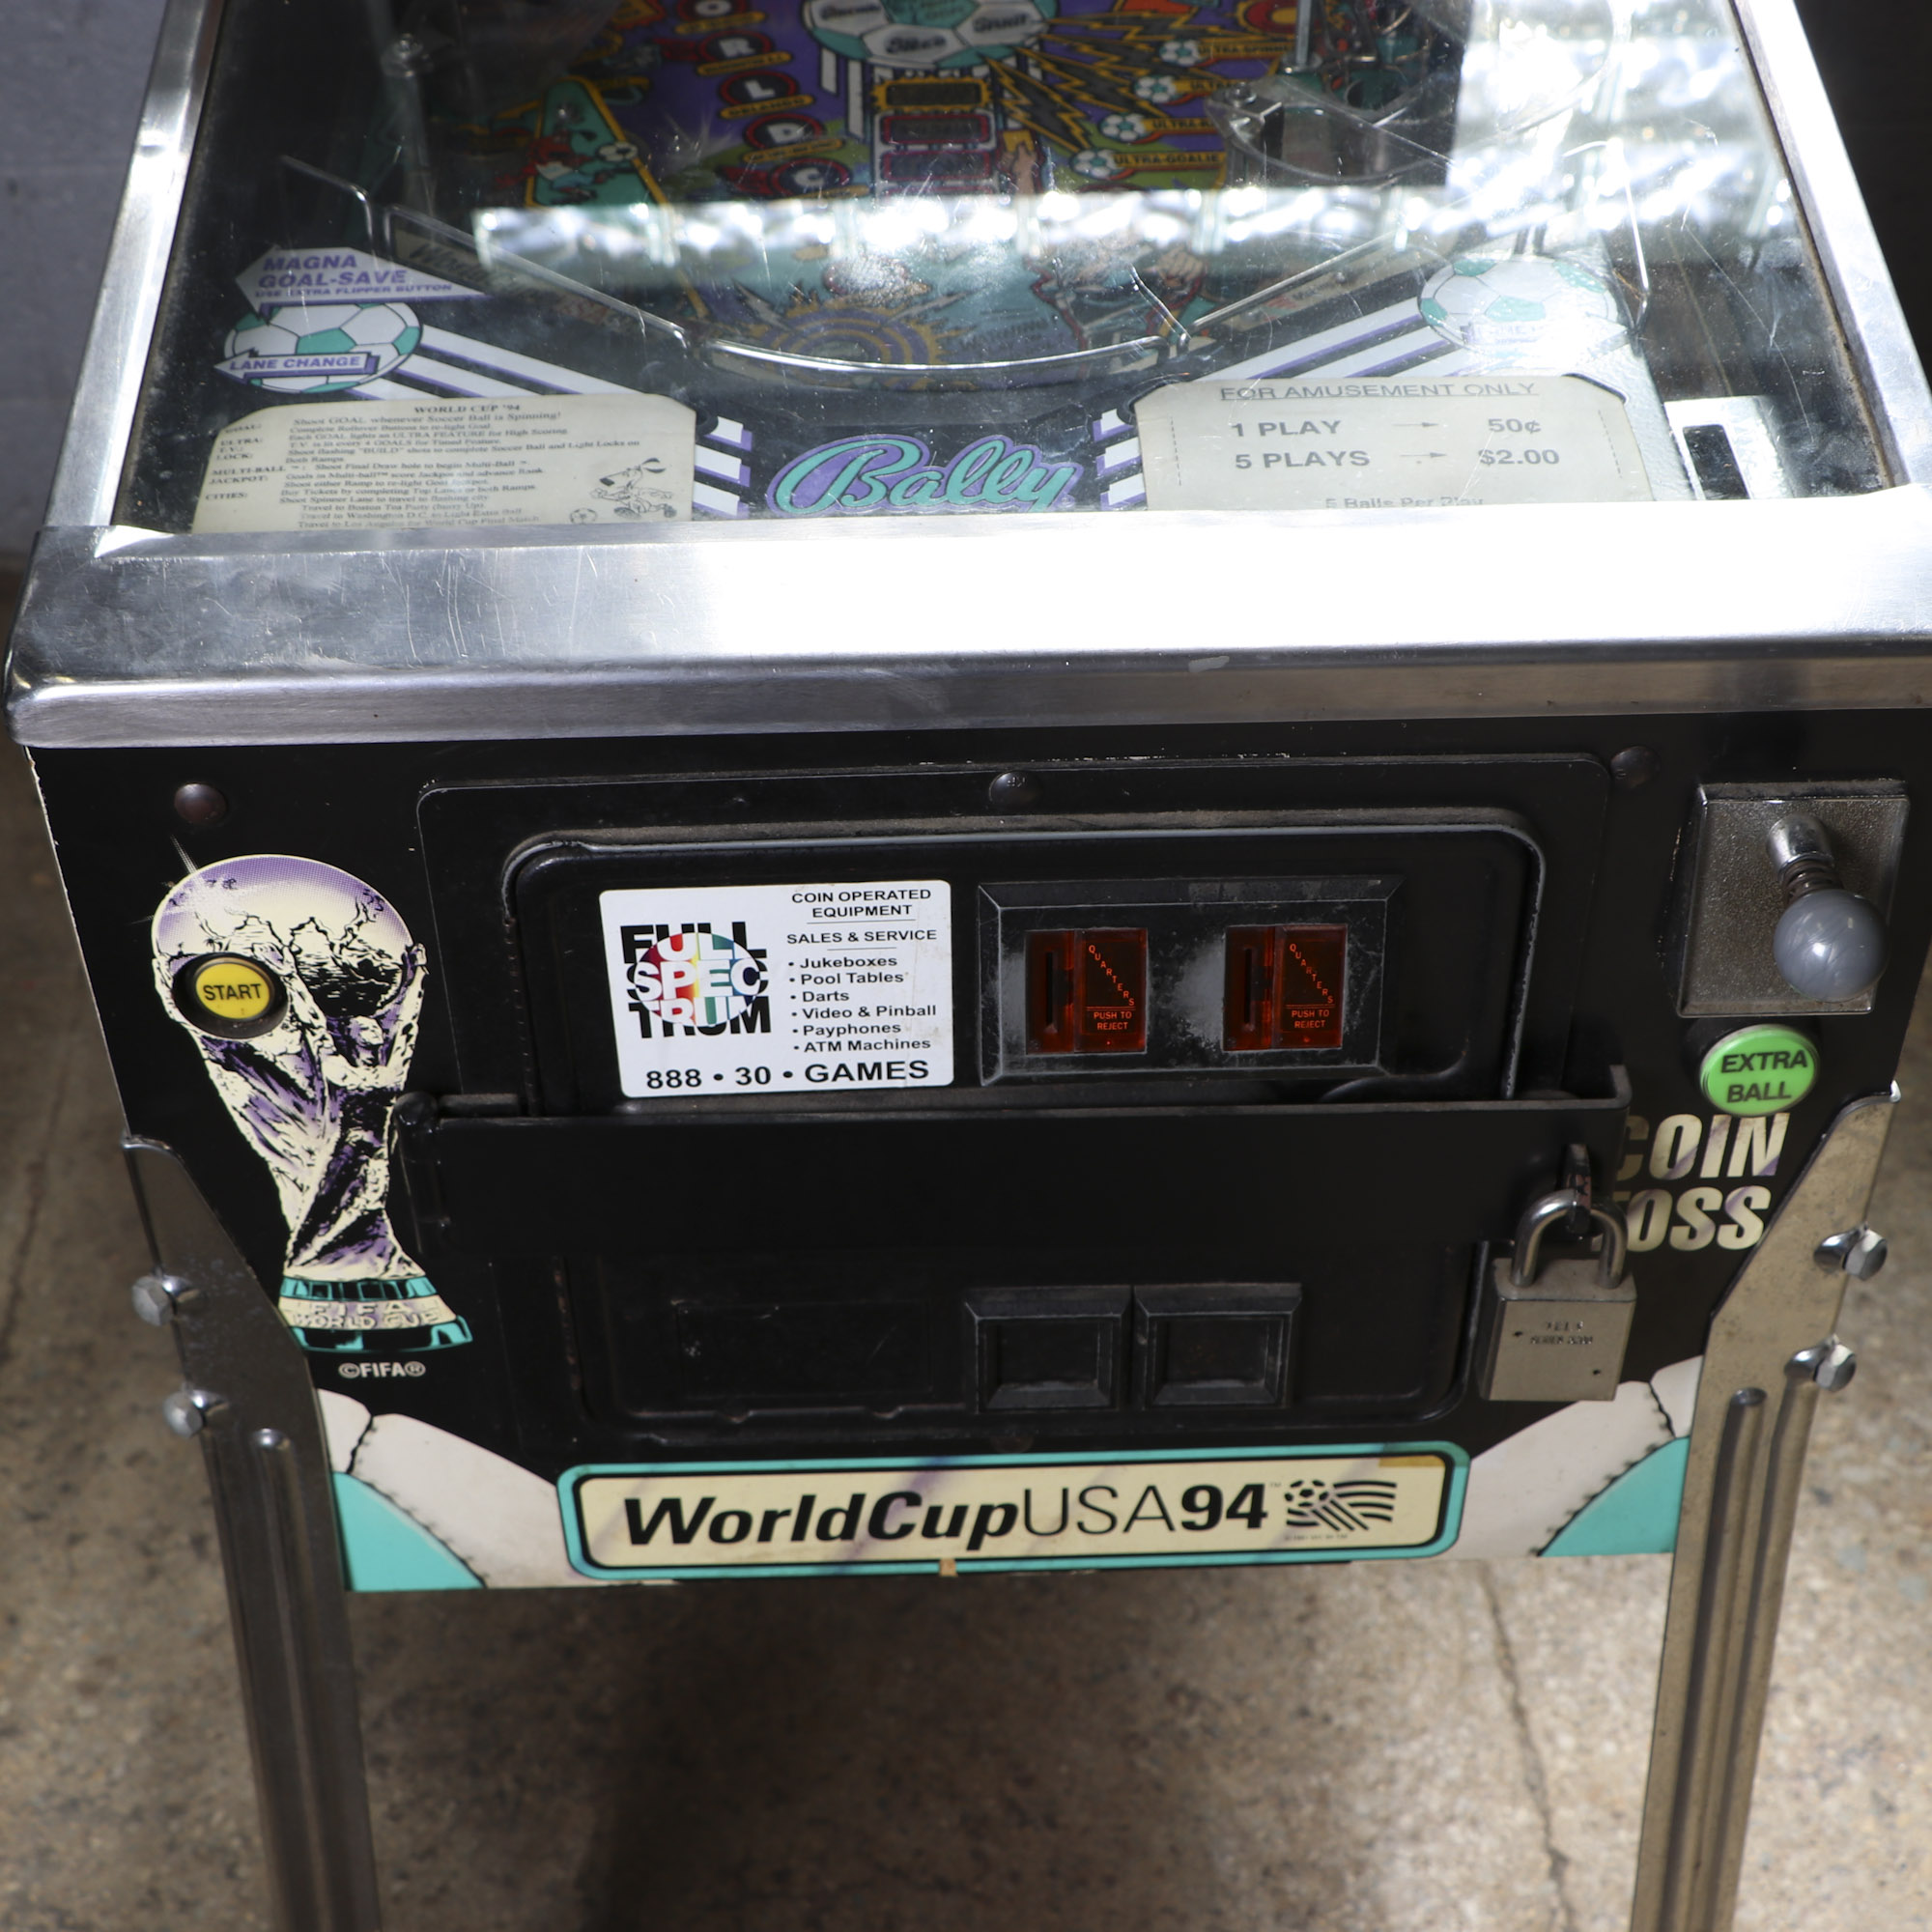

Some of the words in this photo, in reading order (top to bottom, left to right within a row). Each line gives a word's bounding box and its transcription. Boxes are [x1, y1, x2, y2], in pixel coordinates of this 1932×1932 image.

[744, 80, 776, 99] L
[263, 255, 357, 271] MAGNA
[258, 270, 408, 289] GOAL-SAVE
[335, 286, 391, 296] FLIPPER
[396, 284, 453, 293] BUTTON
[229, 359, 277, 371] LANE
[283, 356, 360, 369] CHANGE
[1220, 388, 1282, 401] FOR
[1285, 384, 1455, 400] AMUSEMENT
[1463, 383, 1536, 396] ONLY
[507, 411, 561, 421] Spinning!
[1232, 423, 1246, 438] 1
[1259, 421, 1343, 436] PLAY
[1488, 417, 1542, 435] 50¢
[1236, 454, 1252, 470] 5
[1263, 450, 1371, 469] PLAYS
[1478, 447, 1560, 467] $2.00
[772, 437, 1080, 513] Bally
[791, 892, 834, 904] COIN
[838, 889, 931, 902] OPERATED
[811, 904, 913, 919] EQUIPMENT
[620, 921, 767, 964] FULL
[786, 931, 843, 945] SALES
[847, 930, 860, 943] &
[864, 929, 938, 942] SERVICE
[799, 954, 898, 969] Jukeboxes
[626, 958, 769, 1002] SPEC
[801, 972, 841, 985] Pool
[846, 970, 904, 983] Tables
[1088, 944, 1135, 1007] QUARTERS
[1289, 943, 1334, 1005] QUARTERS
[202, 981, 263, 1002] START
[802, 990, 850, 1003] Darts
[628, 995, 772, 1038] TRUM
[802, 1007, 852, 1020] Video
[857, 1006, 871, 1018] &
[875, 1005, 937, 1017] Pinball
[1093, 1011, 1118, 1020] PUSH
[1121, 1010, 1132, 1020] TO
[1291, 1009, 1316, 1018] PUSH
[1319, 1009, 1330, 1018] TO
[803, 1021, 901, 1038] Payphones
[1096, 1021, 1128, 1031] REJECT
[1293, 1019, 1325, 1029] REJECT
[804, 1040, 842, 1053] ATM
[848, 1037, 931, 1052] Machines
[1719, 1049, 1808, 1074] EXTRA
[645, 1067, 702, 1090] 888
[734, 1065, 772, 1086] 30
[805, 1060, 929, 1083] GAMES
[1726, 1081, 1792, 1103] BALL
[311, 1300, 413, 1318] FIFA
[293, 1312, 378, 1329] WORLD
